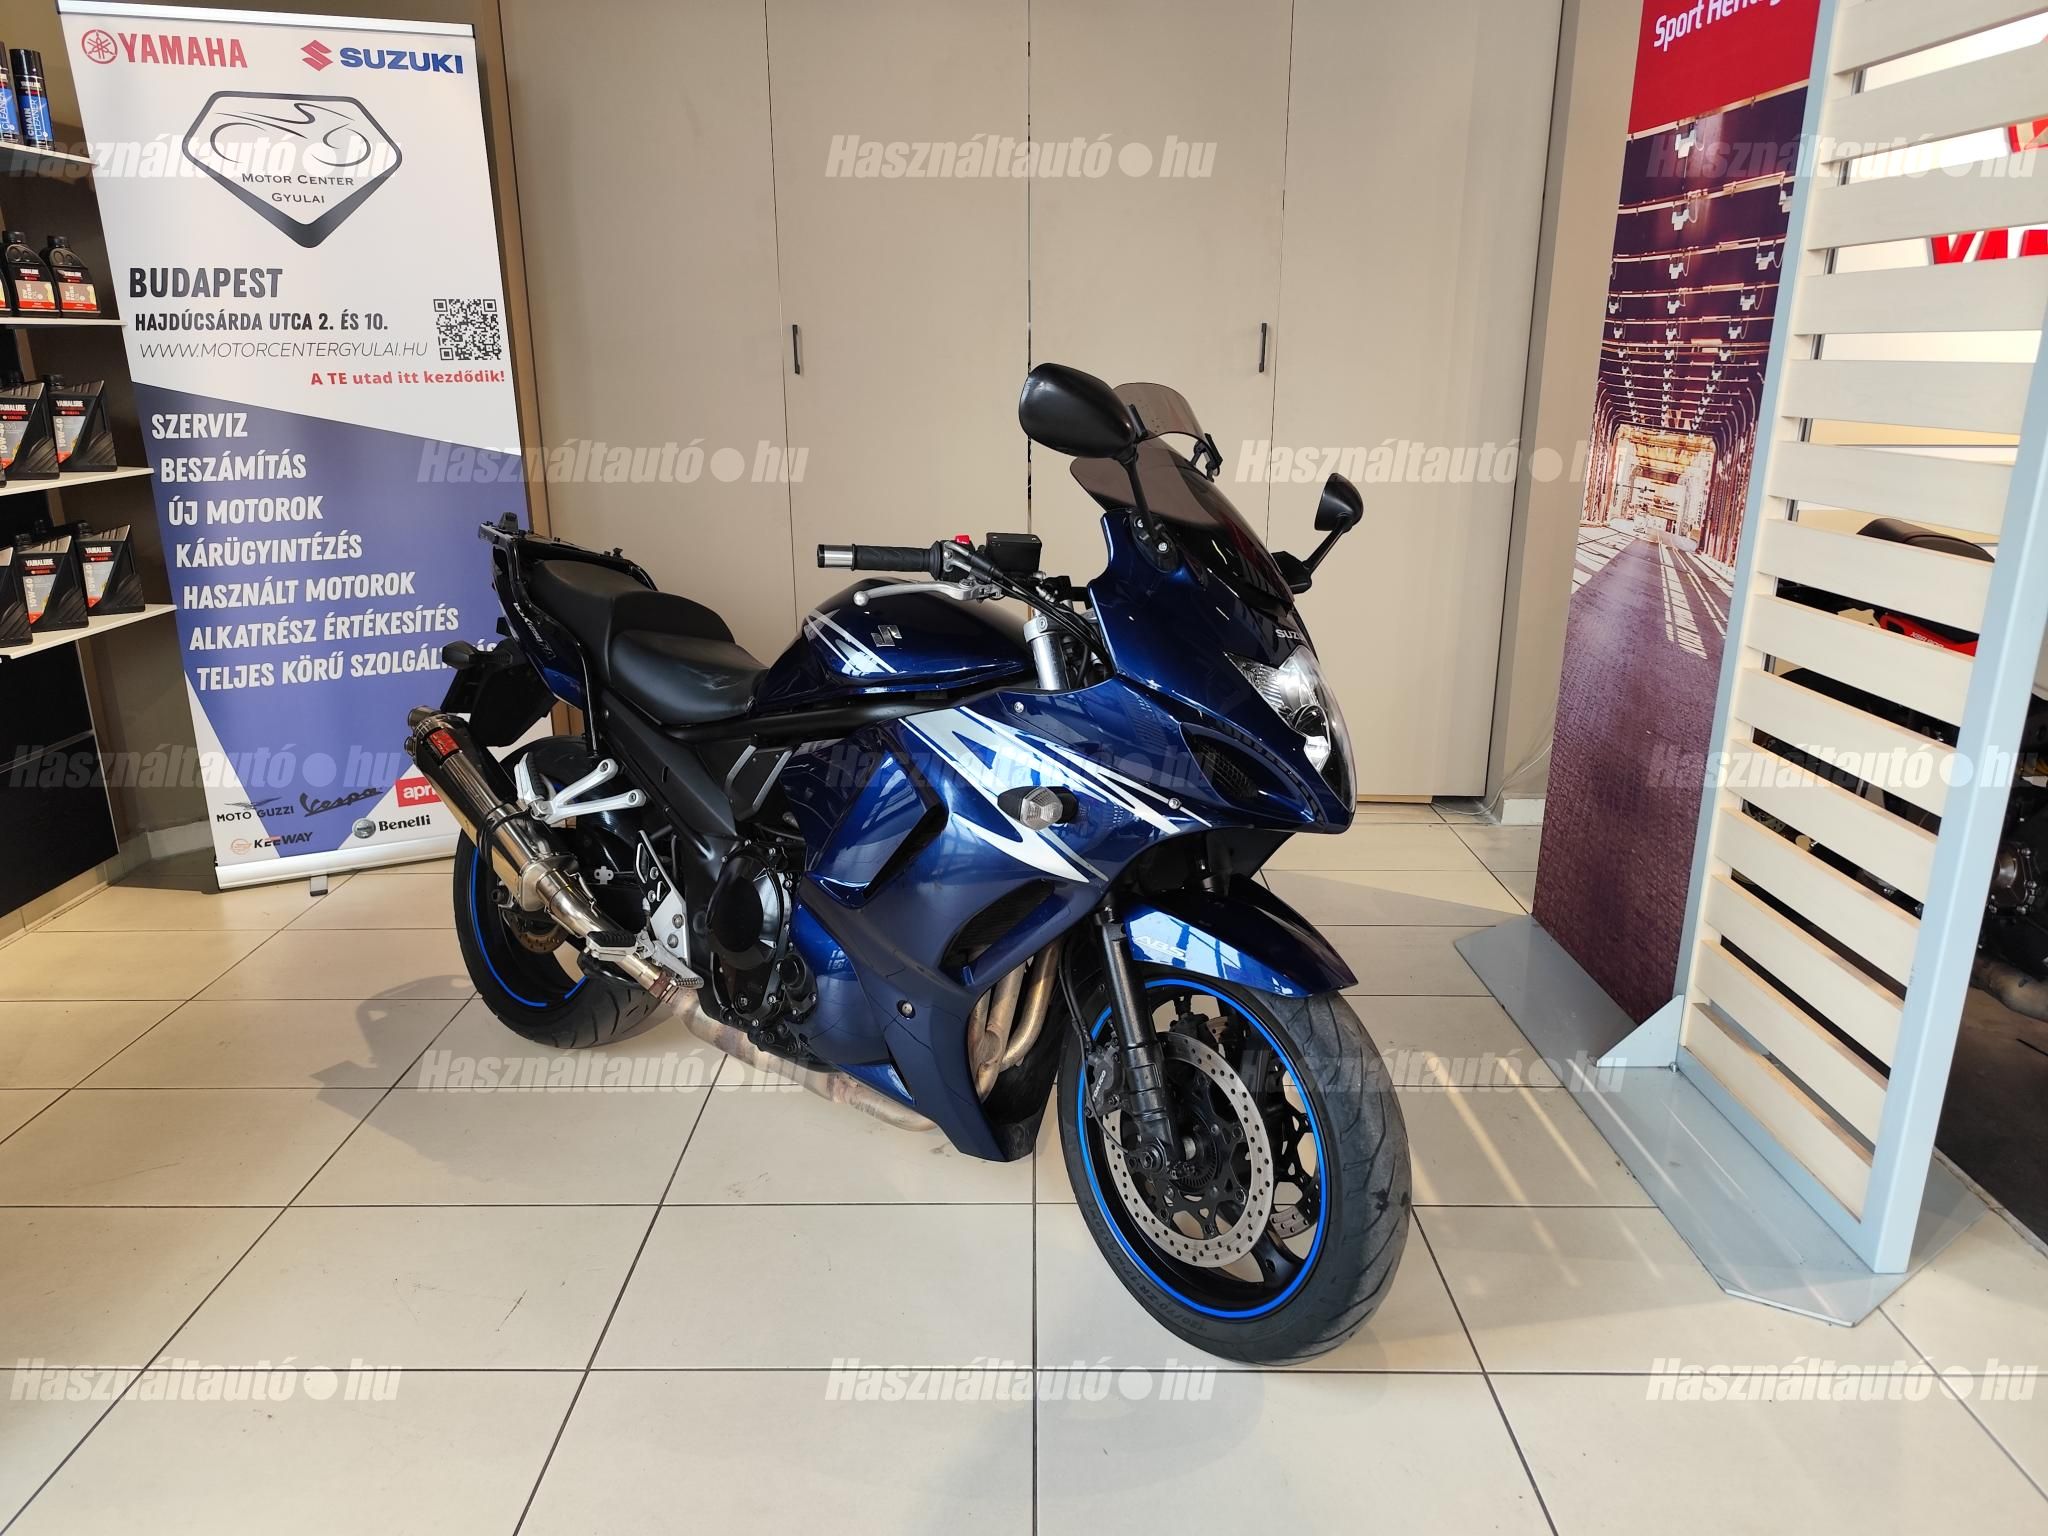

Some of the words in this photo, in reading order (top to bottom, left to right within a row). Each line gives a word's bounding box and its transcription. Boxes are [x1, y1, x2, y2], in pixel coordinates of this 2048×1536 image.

[1653, 0, 1704, 52] Sport
[118, 33, 248, 68] YAMAHA
[340, 47, 464, 74] SUZUKI
[0, 92, 10, 131] CLEANE
[24, 108, 35, 136] CHAIN
[31, 99, 43, 137] CLEANER
[242, 173, 292, 184] MOTOR
[297, 174, 354, 186] CENTER
[271, 192, 325, 204] GYULAI
[129, 267, 283, 298] BUDAPEST
[135, 309, 263, 331] HAJDÚCSÁRDA
[269, 312, 313, 330] UTCA
[318, 312, 334, 330] 2.
[340, 309, 359, 330] ÉS
[364, 312, 389, 330] 10.
[140, 342, 428, 359] WWW.MOTORCENTERGYULAI.HU
[311, 372, 323, 385] A
[327, 372, 348, 385] TE
[353, 371, 393, 385] utad
[399, 370, 419, 384] itt
[424, 370, 505, 384] kezdődik!
[151, 412, 248, 440] SZERVIZ
[161, 449, 307, 483] BESZÁMÍTÁS
[168, 495, 198, 526] ÚJ
[206, 495, 324, 525] MOTOROK
[176, 529, 363, 568] KÁRÜGYINTÉZÉS
[183, 576, 299, 610] HASZNÁLT
[306, 571, 416, 602] MOTOROK
[189, 615, 317, 651] ALKATRÉSZ
[323, 603, 459, 641] ÉRTÉKESÍTÉS
[1275, 629, 1304, 640] SUZ
[197, 662, 274, 691] TELJES
[282, 651, 344, 685] KÖRŰ
[216, 811, 251, 822] MOTO
[256, 805, 295, 818] GUZZI
[300, 787, 384, 817] Vespa
[378, 814, 431, 832] Benelli
